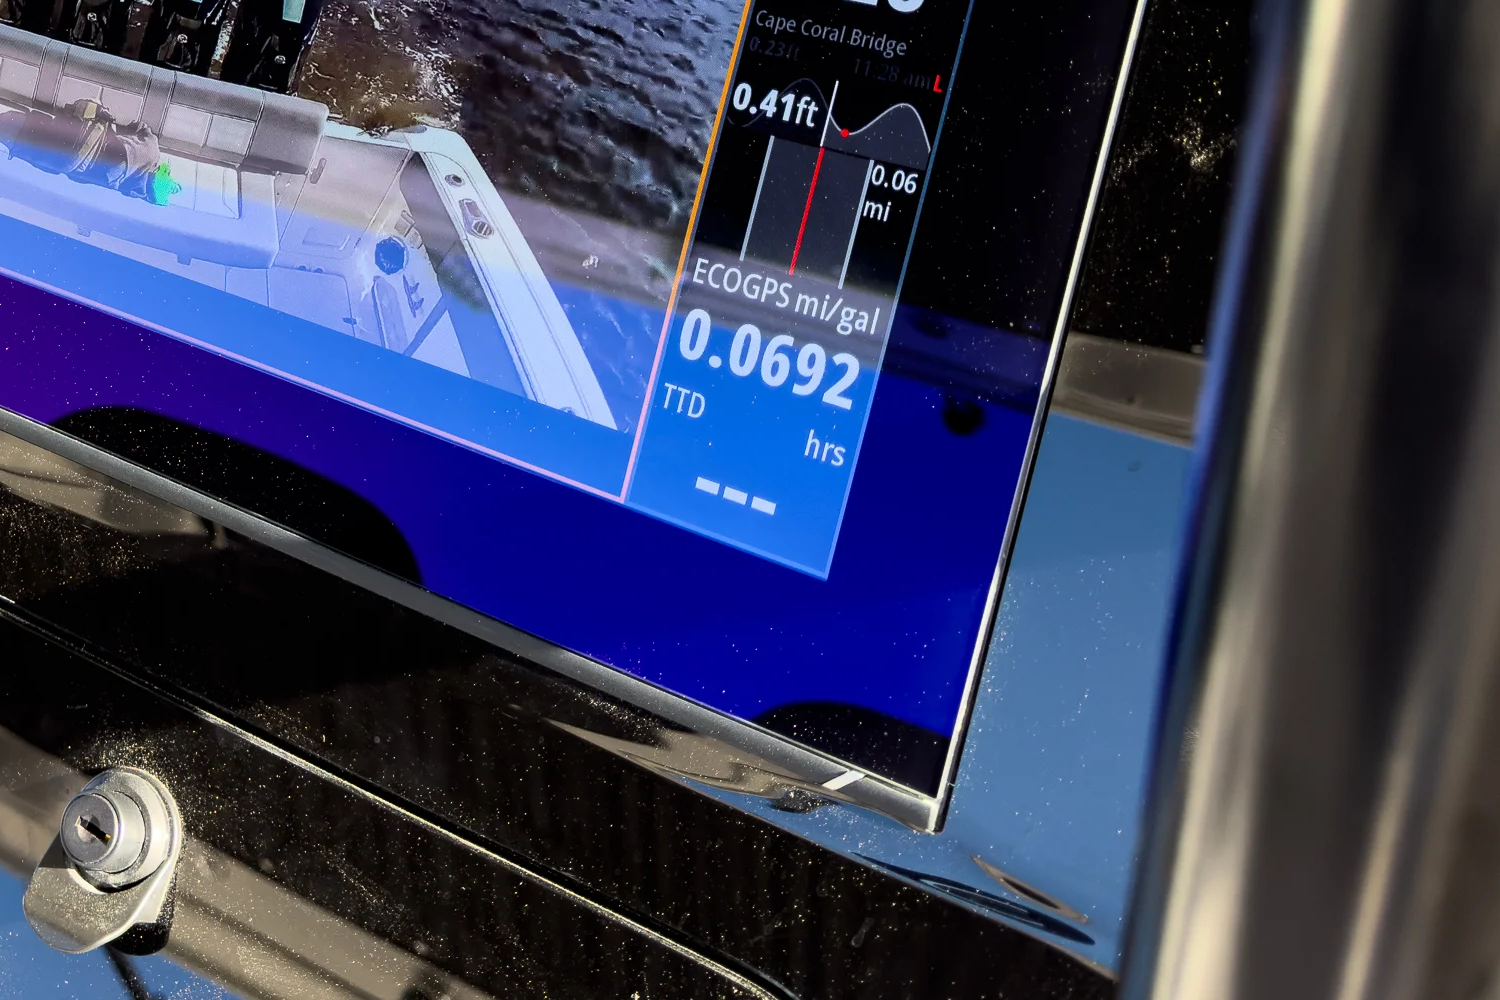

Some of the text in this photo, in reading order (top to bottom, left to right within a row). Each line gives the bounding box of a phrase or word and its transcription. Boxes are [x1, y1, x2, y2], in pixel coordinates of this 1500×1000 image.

[755, 9, 907, 59] Cape Coral Bridge
[932, 74, 943, 93] L
[732, 81, 819, 128] 0.41ft
[870, 164, 918, 195] 0.06
[862, 199, 892, 223] mi
[691, 257, 880, 336] ECOGPS mi/gal
[678, 307, 861, 411] 0.0692
[663, 382, 706, 419] TTD
[803, 429, 846, 467] hrs
